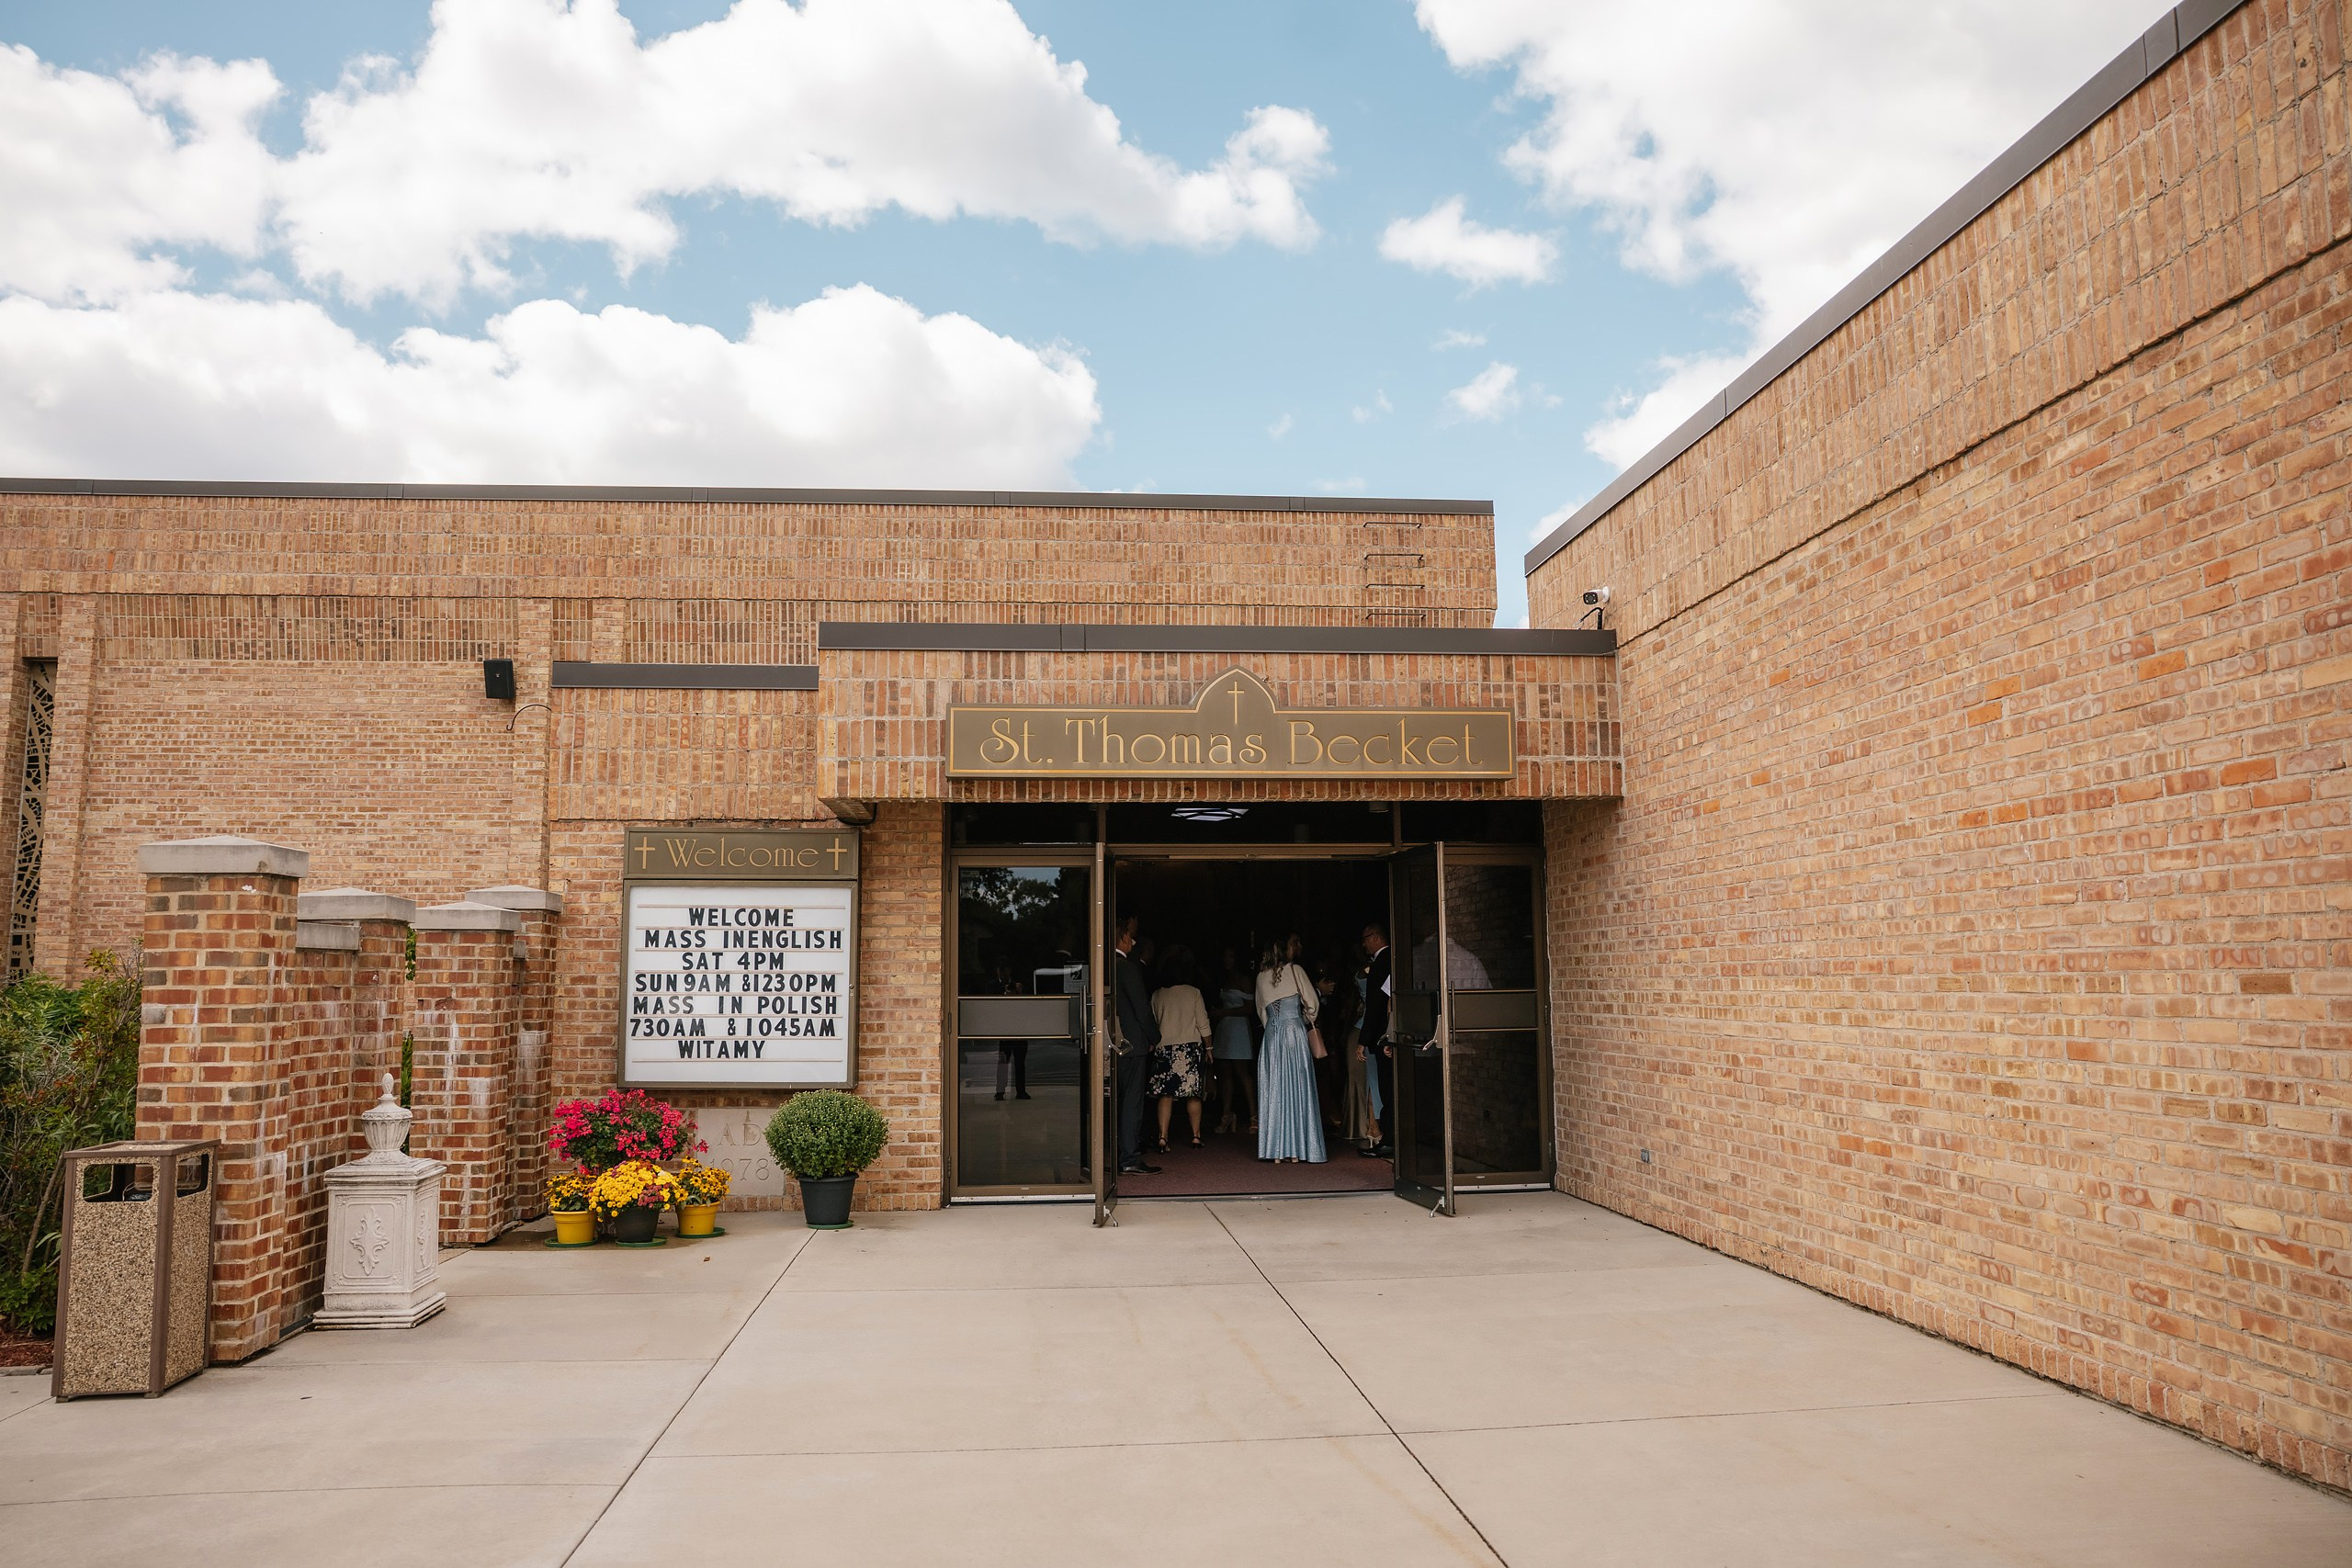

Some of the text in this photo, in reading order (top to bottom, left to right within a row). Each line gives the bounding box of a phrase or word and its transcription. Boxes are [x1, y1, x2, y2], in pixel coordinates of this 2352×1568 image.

[979, 715, 1485, 765] St. Thomas Becket
[664, 837, 820, 868] Welcome
[688, 908, 794, 927] WELCOME
[645, 930, 707, 948] MASS
[682, 951, 785, 970] SAT 4PM
[633, 996, 837, 1015] MASS IN POLISH
[630, 1018, 706, 1037] 730AM
[678, 1040, 765, 1059] WITAMY
